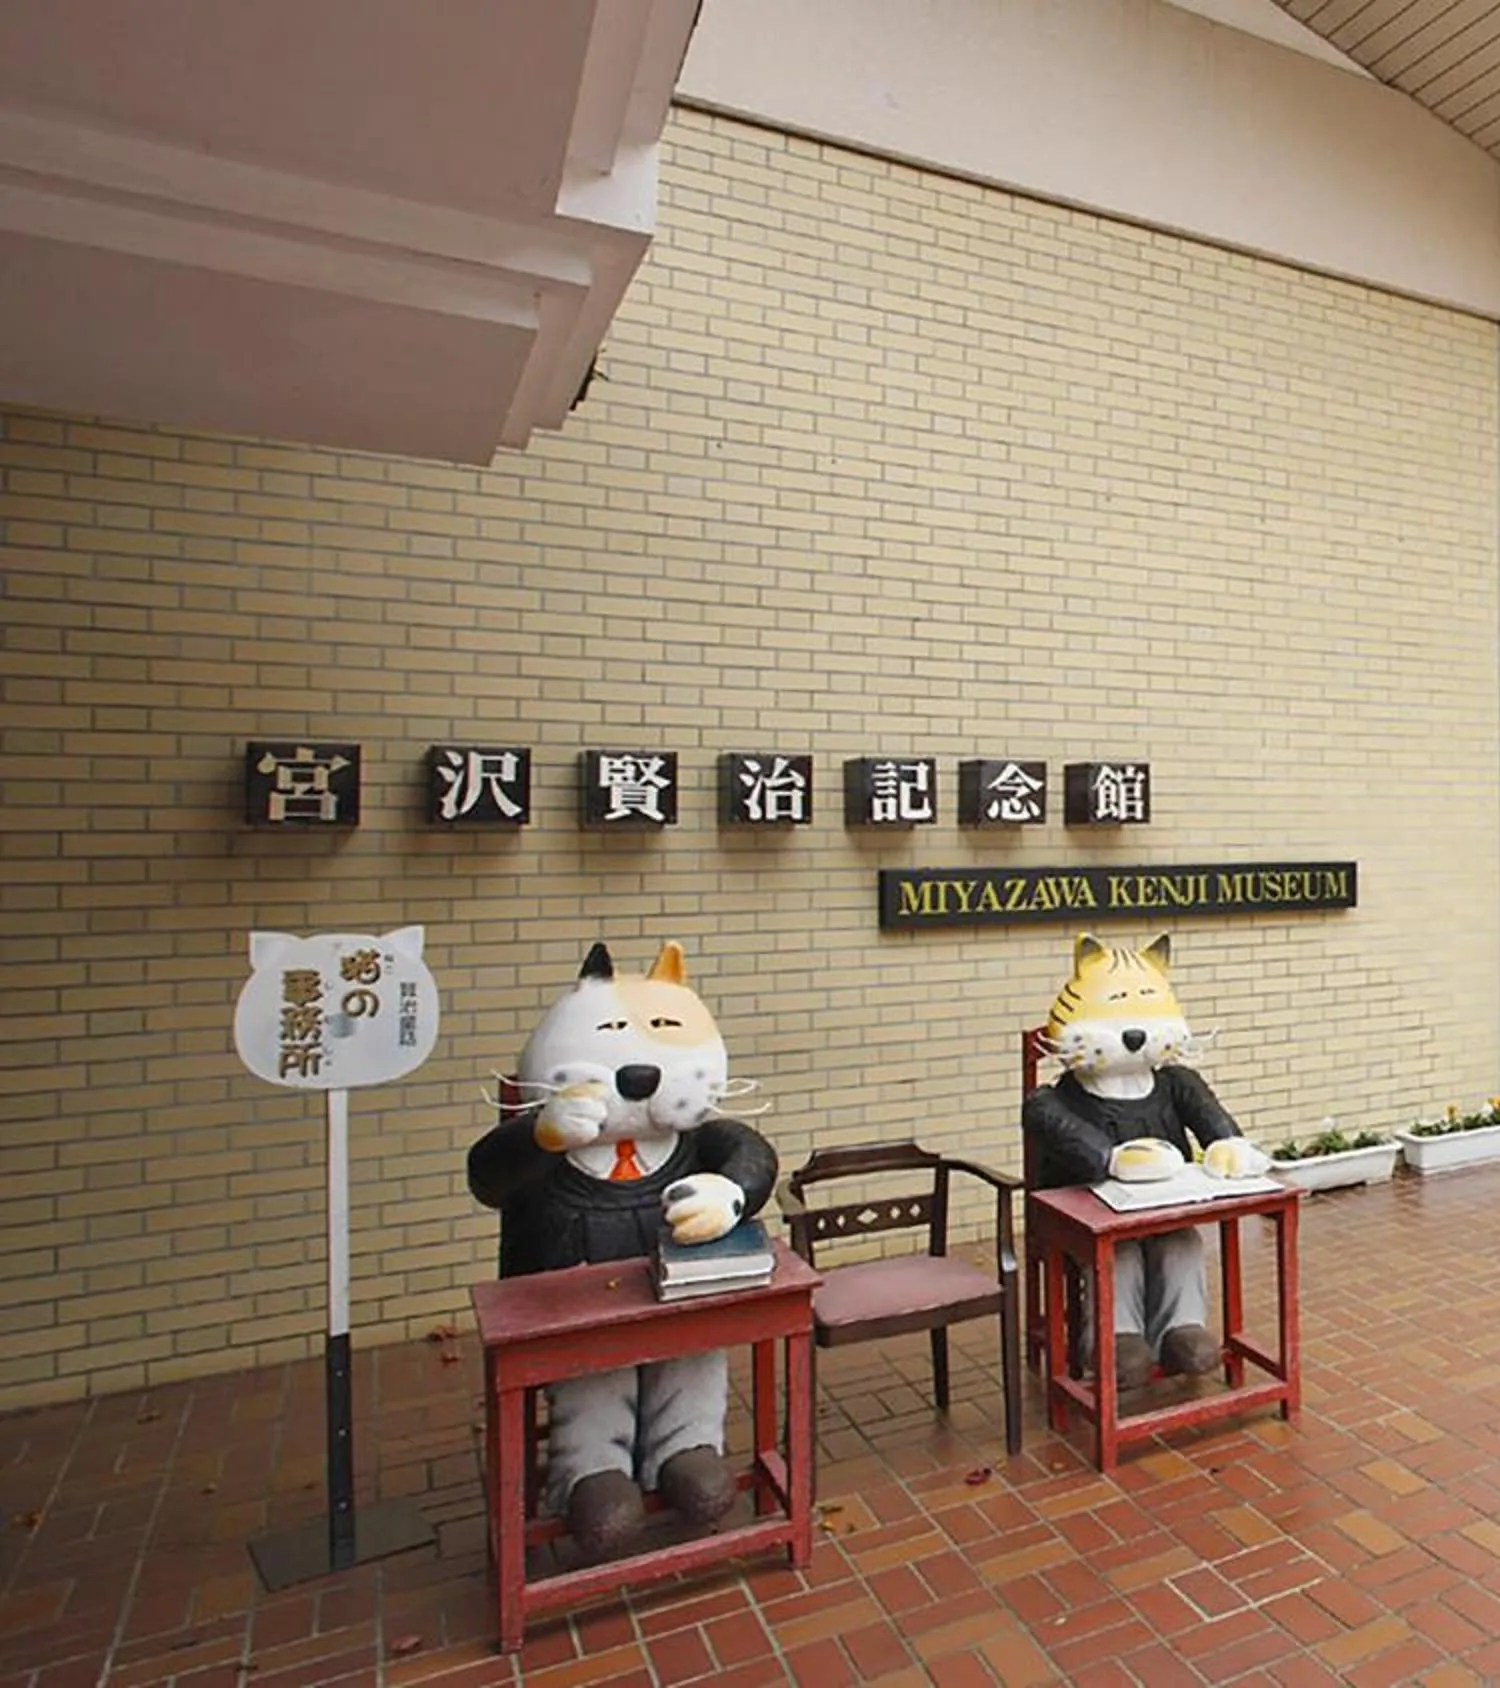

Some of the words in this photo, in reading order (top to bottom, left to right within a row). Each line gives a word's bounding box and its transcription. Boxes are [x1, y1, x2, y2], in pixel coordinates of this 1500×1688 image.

[256, 746, 1146, 822] 宮沢賢治記念館
[897, 876, 1097, 915] MIYAZAWA
[1107, 872, 1209, 908] KENJI
[1216, 869, 1348, 904] MUSEUM
[278, 968, 324, 1080] 事務所
